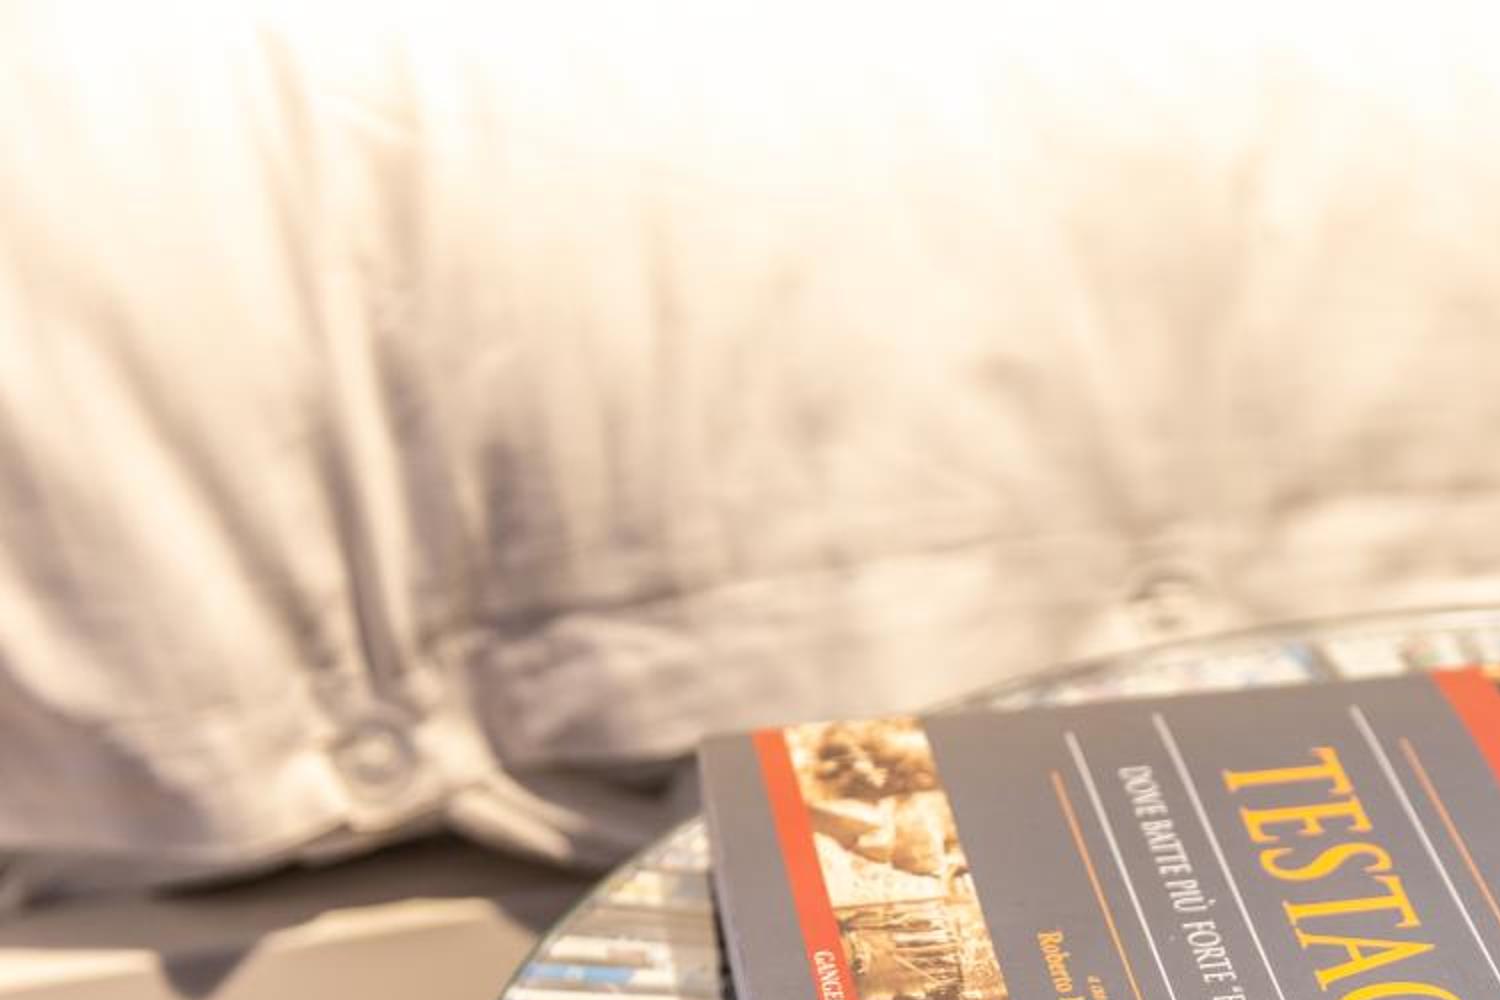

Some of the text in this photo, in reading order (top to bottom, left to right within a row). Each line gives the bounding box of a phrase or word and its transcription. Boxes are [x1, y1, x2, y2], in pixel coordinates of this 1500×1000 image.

[1118, 765, 1167, 818] DOVE
[1142, 818, 1193, 876] BATTE
[1164, 880, 1216, 914] PIÙ
[1037, 931, 1073, 993] Roberto
[1182, 921, 1237, 984] FORTE
